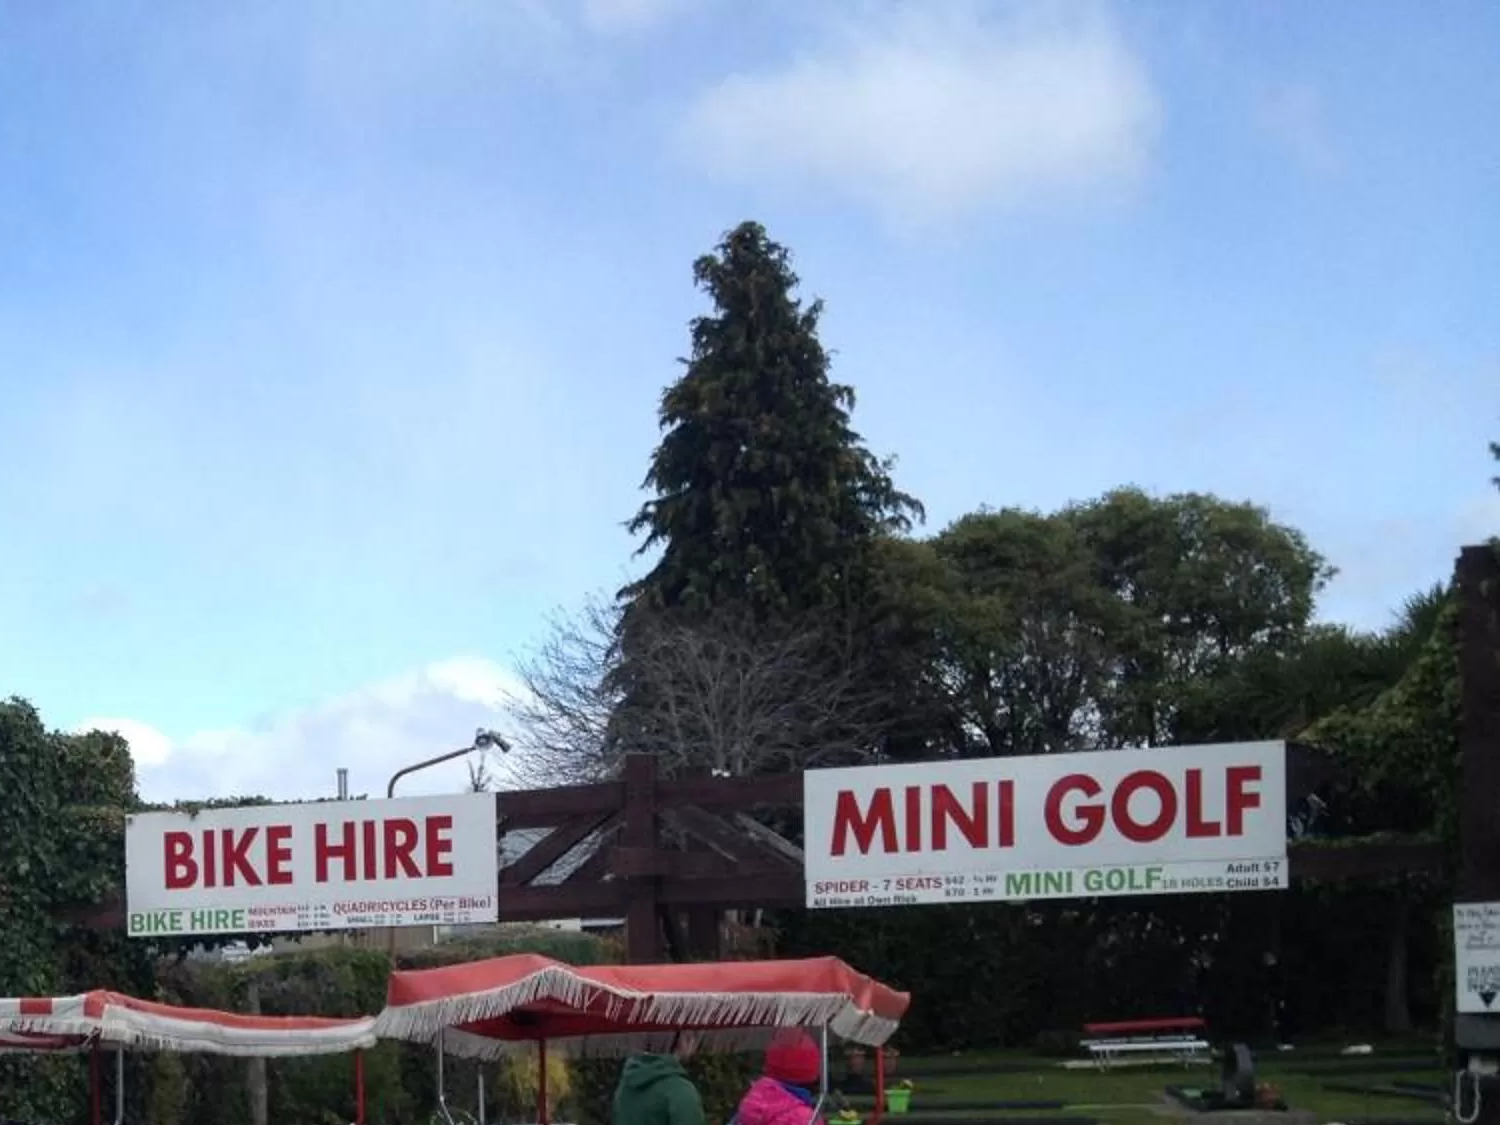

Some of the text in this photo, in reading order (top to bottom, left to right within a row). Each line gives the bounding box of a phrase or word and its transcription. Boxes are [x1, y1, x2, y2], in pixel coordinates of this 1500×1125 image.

[830, 765, 1262, 857] MINI GOLF
[163, 815, 454, 890] BIKE HIRE
[1227, 863, 1259, 873] Adult
[814, 880, 869, 895] SPIDER
[883, 879, 890, 891] 7
[895, 876, 942, 891] SEATS
[1005, 871, 1073, 896] MINI
[1083, 867, 1163, 892] GOLF
[1181, 877, 1223, 889] HOLES
[1226, 876, 1259, 888] Child
[333, 899, 427, 916] QUADRICYCLES
[130, 909, 245, 932] BIKE HIRE
